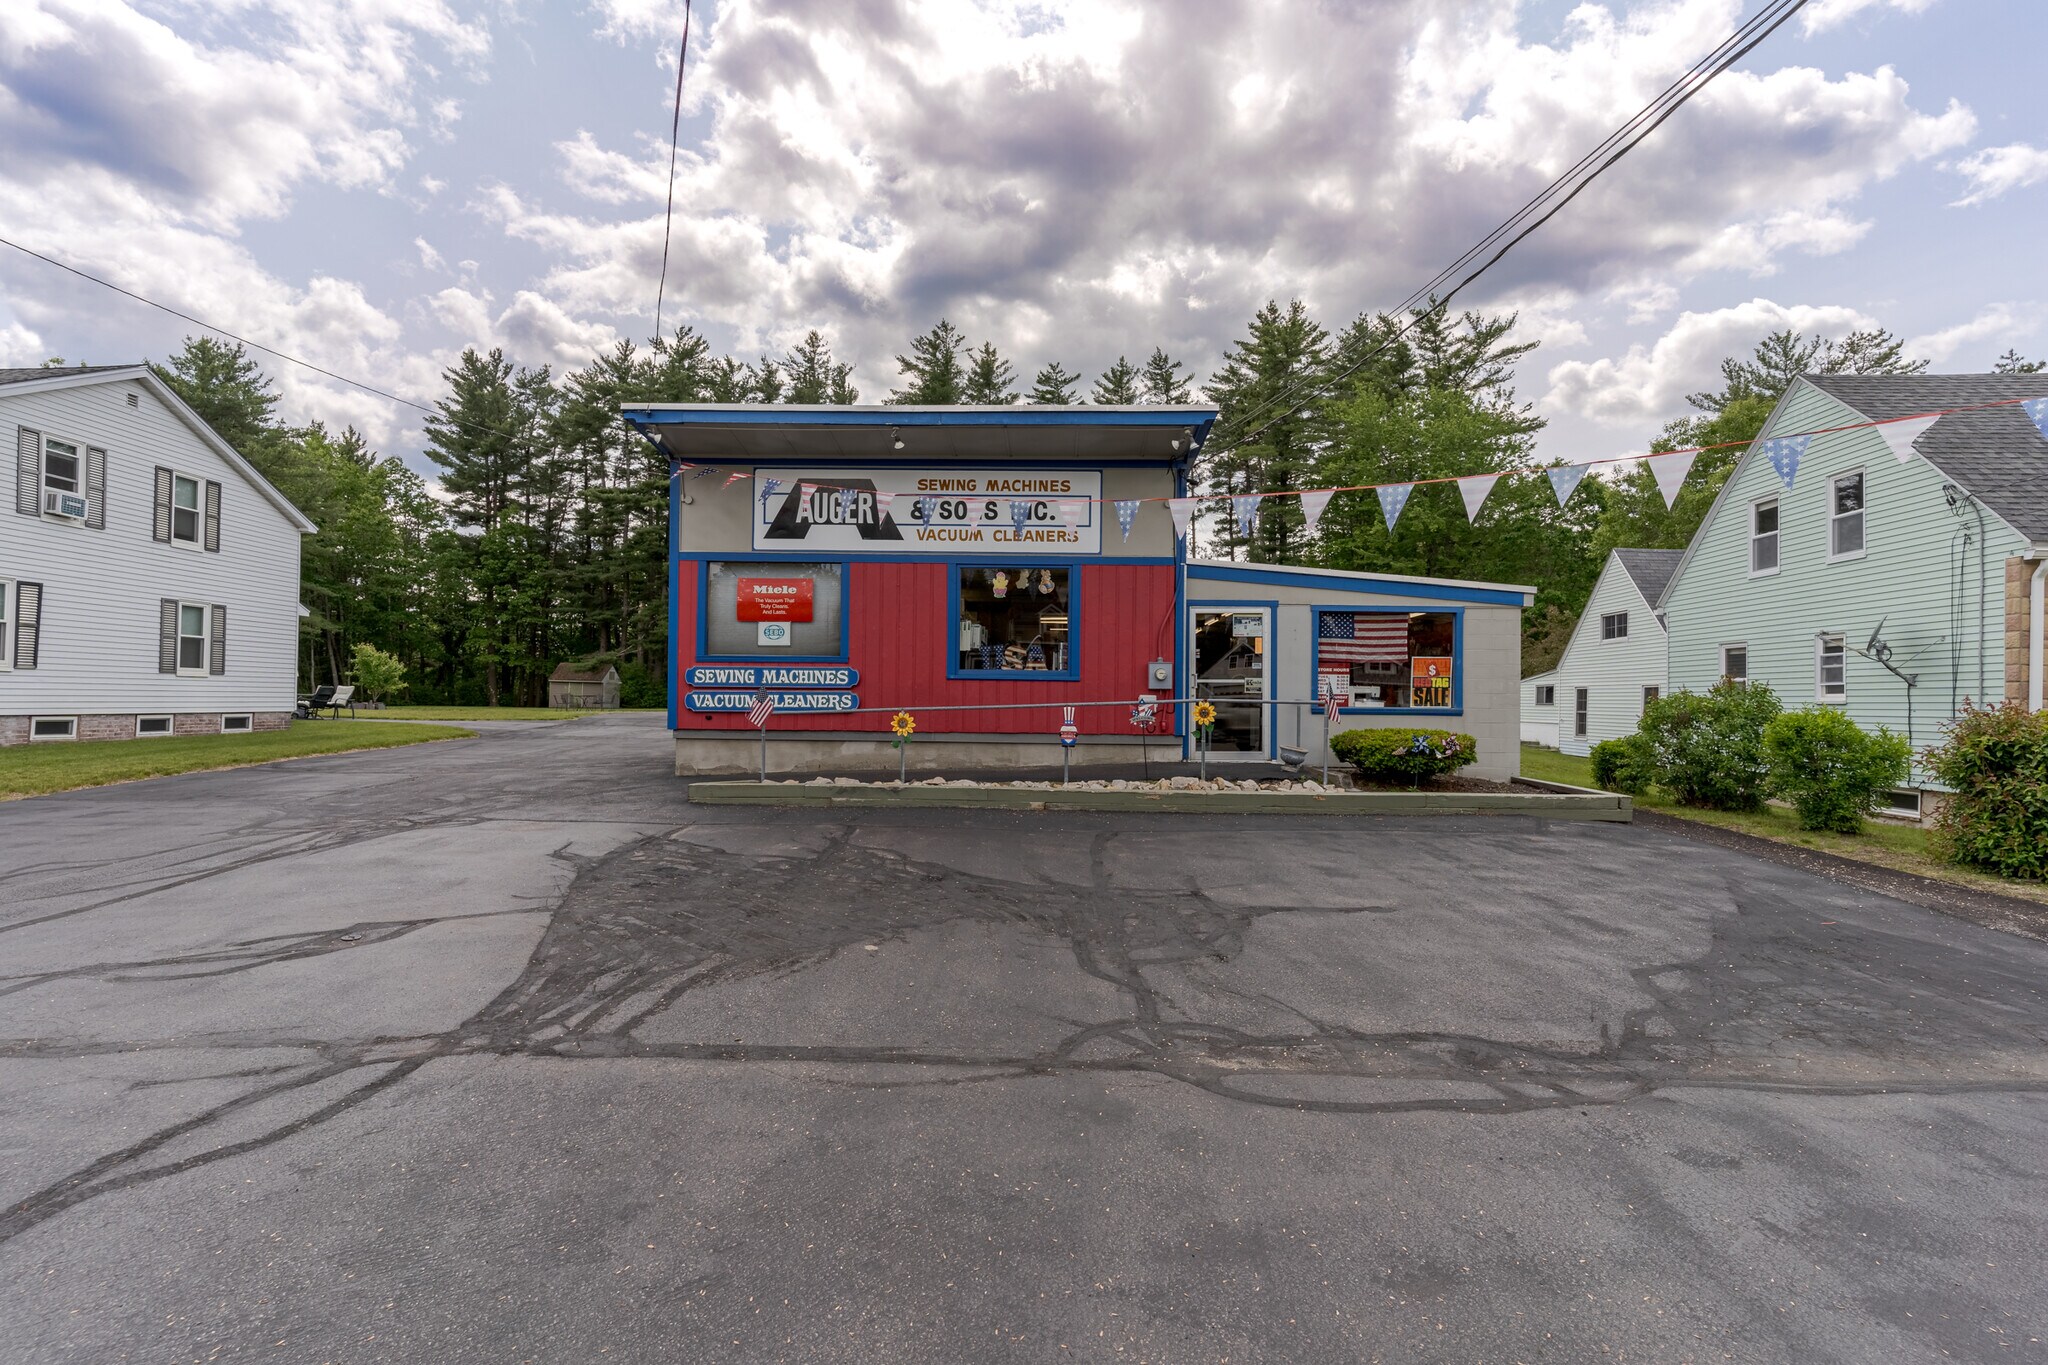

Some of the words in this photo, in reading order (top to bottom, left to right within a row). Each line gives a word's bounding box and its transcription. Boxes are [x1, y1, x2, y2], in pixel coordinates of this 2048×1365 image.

[917, 478, 977, 491] SEWING
[986, 479, 1071, 492] MACHINES
[795, 492, 874, 524] AUGER
[939, 500, 998, 521] SOS
[1011, 500, 1056, 521] C.
[916, 528, 983, 542] VACUUM
[752, 585, 797, 594] Miele
[694, 669, 755, 684] SEWING
[761, 670, 849, 685] MACHINES
[1413, 677, 1431, 688] RED
[1431, 677, 1449, 688] TAG
[767, 695, 852, 710] LEANERS
[1413, 688, 1450, 706] SALE
